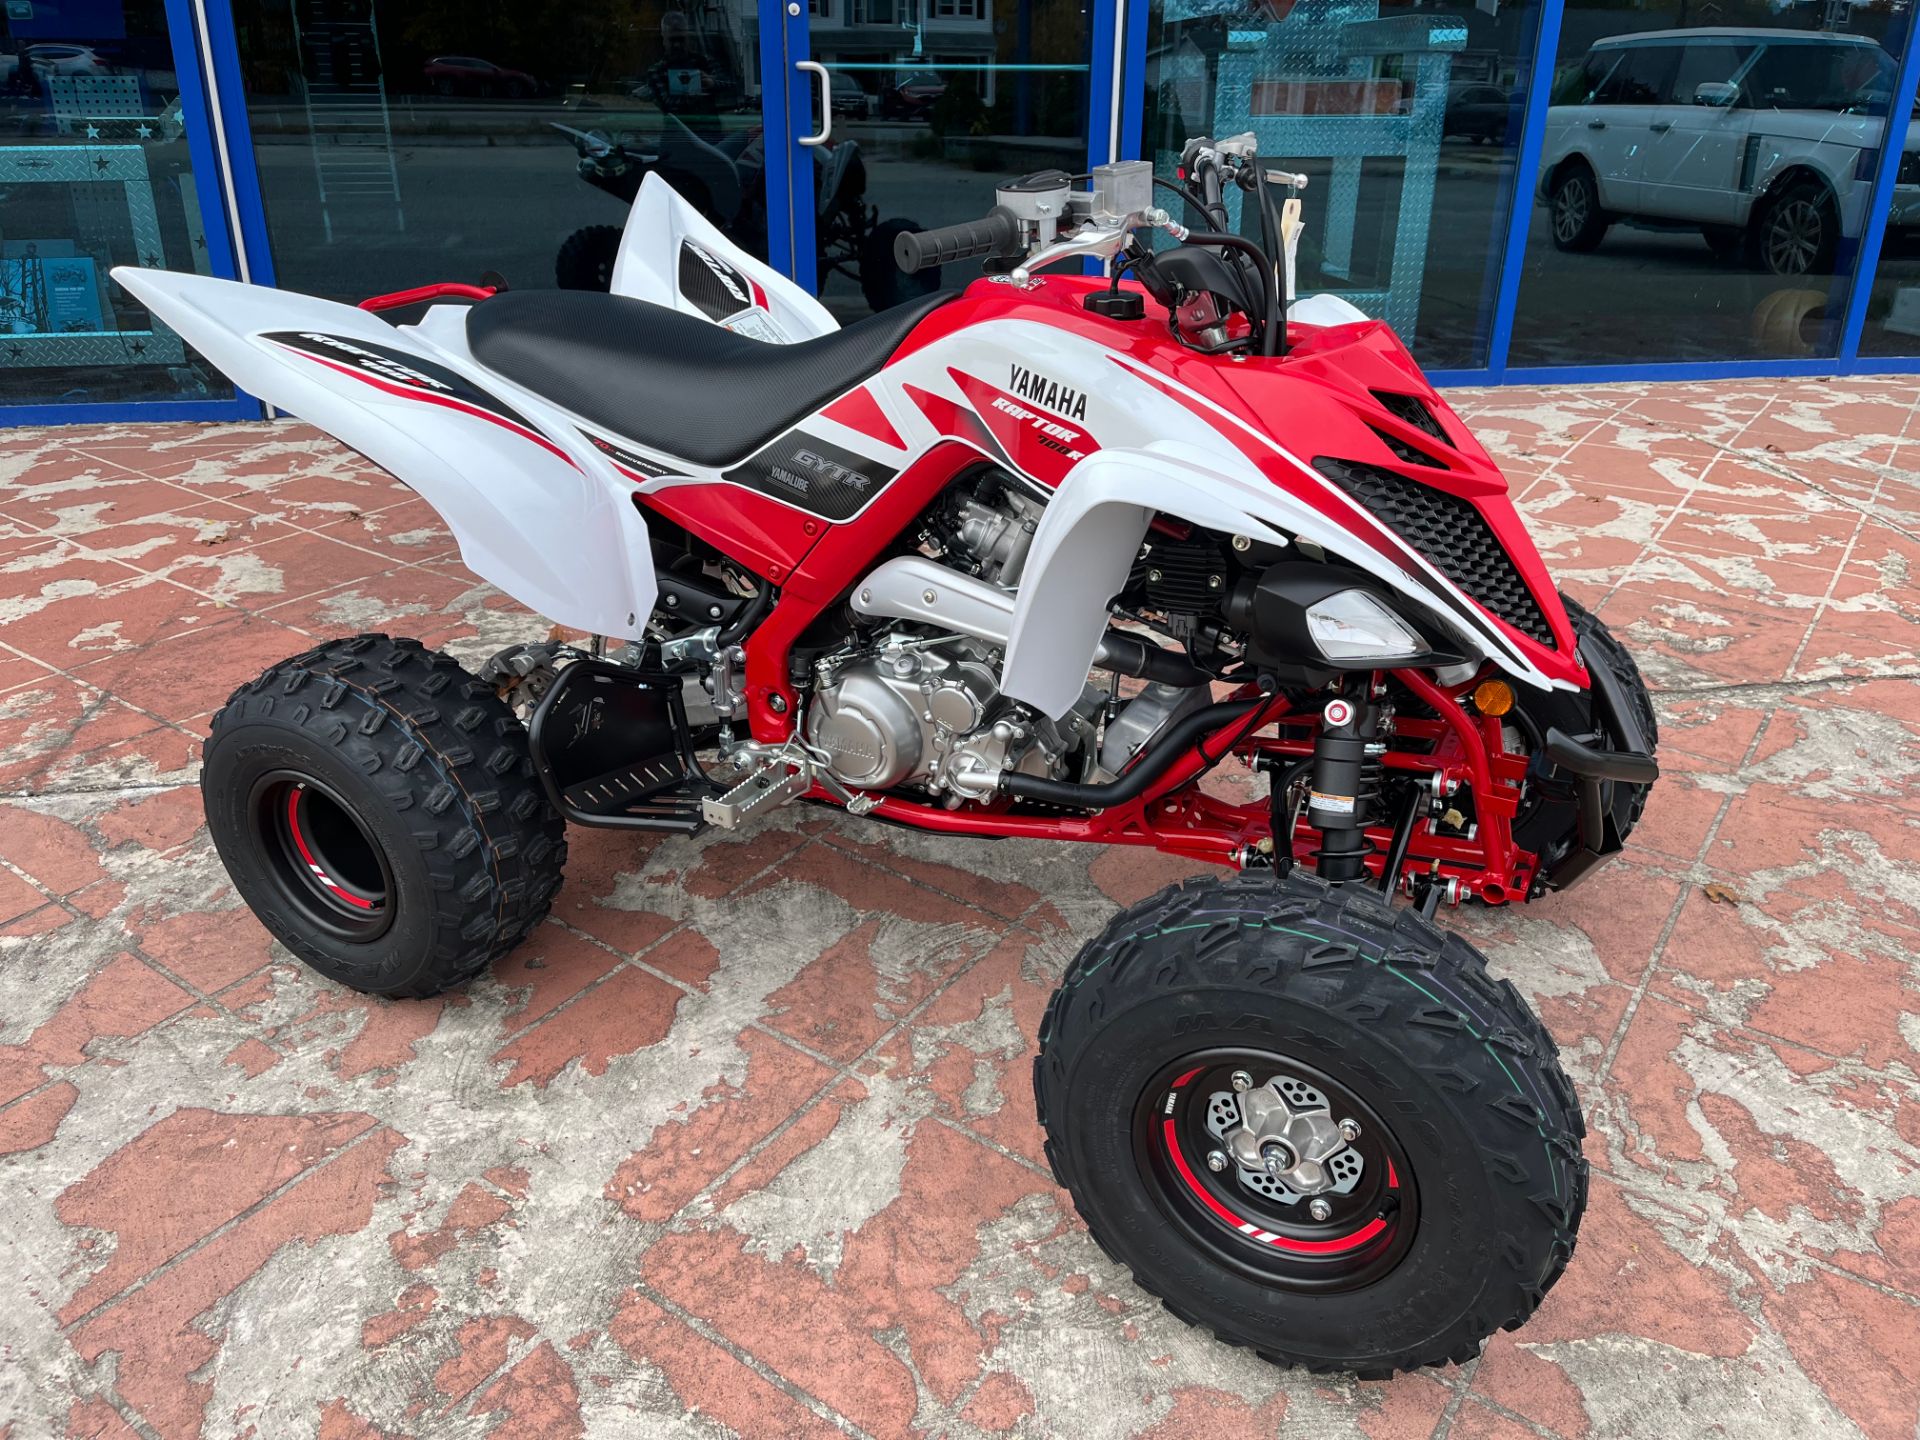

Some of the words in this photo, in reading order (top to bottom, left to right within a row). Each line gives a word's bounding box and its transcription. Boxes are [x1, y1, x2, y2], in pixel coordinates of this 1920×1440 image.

[1009, 363, 1087, 421] YAMAHA
[991, 397, 1081, 443] RAPTOR
[1037, 434, 1085, 461] 700R
[770, 465, 810, 492] YAMALUBE
[791, 448, 871, 492] GYTR
